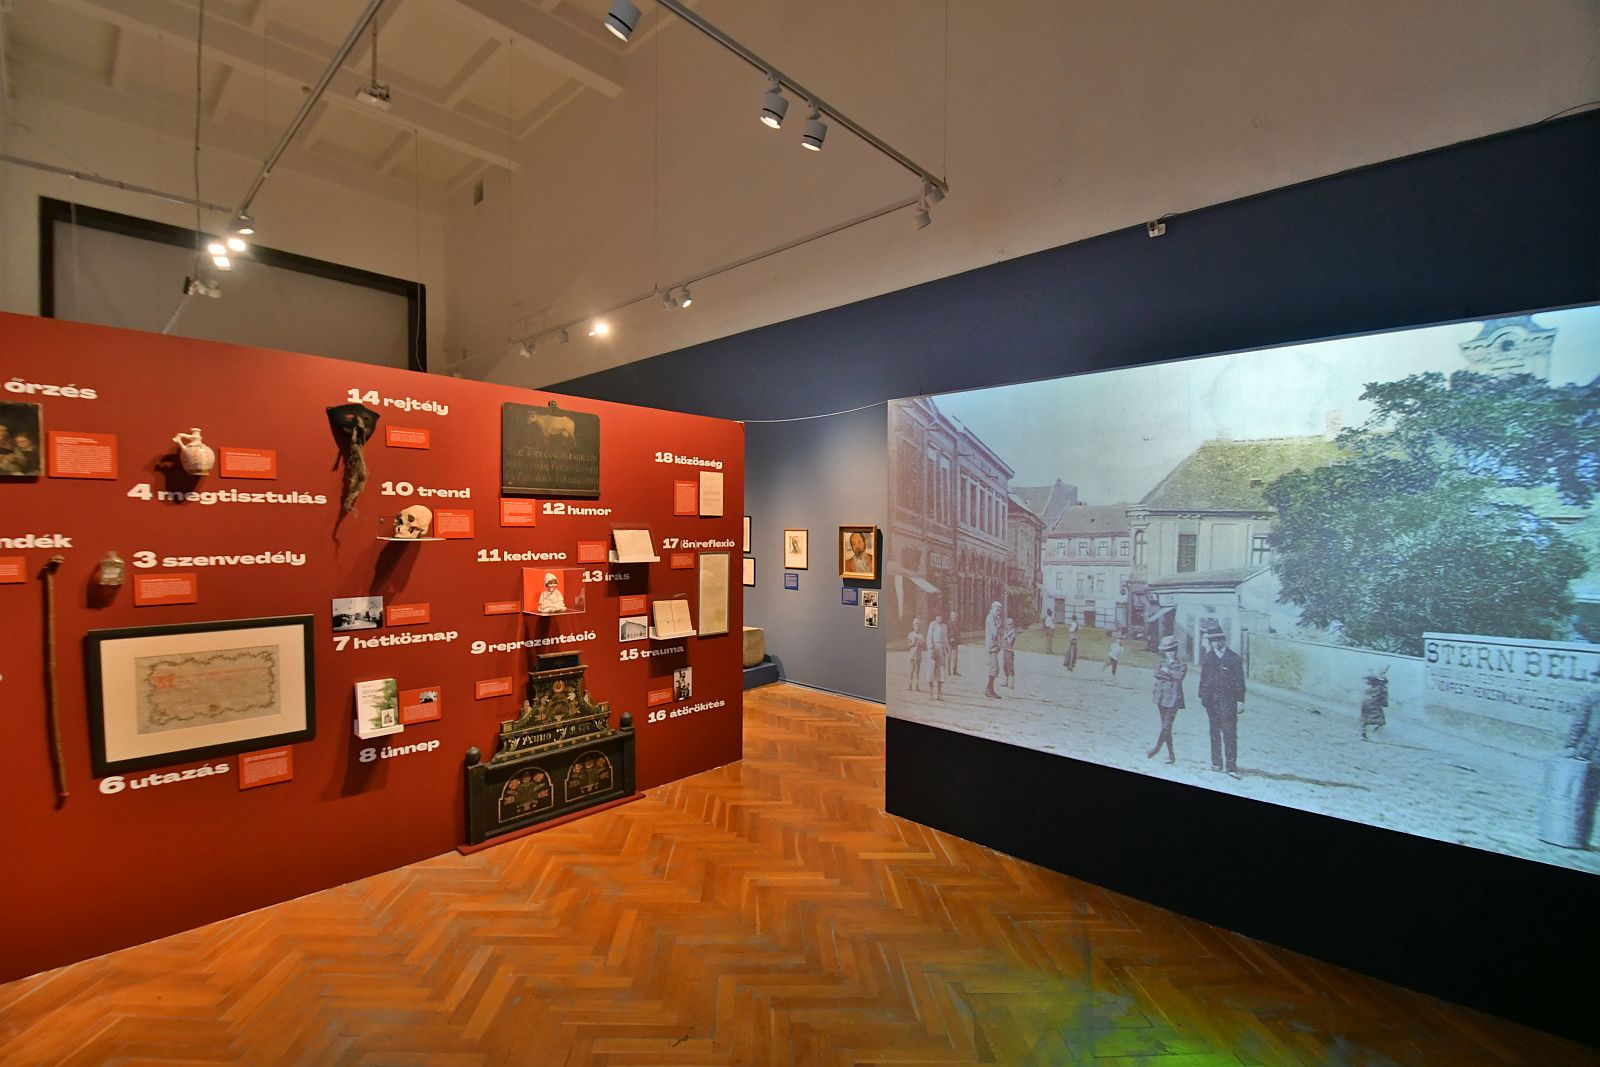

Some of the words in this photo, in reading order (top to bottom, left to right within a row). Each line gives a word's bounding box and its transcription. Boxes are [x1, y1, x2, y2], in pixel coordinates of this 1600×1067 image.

[4, 377, 98, 399] őrzés
[347, 388, 380, 406] 14
[384, 396, 449, 416] rejtély
[654, 451, 673, 464] 18
[674, 455, 723, 469] közösség
[127, 483, 152, 501] 4
[157, 489, 328, 506] megtisztulás
[381, 481, 414, 497] 10
[417, 485, 471, 499] trend
[542, 502, 565, 515] 12
[567, 504, 612, 516] humor
[662, 538, 679, 549] 17
[132, 550, 157, 569] 3
[161, 550, 308, 569] szenvedély
[477, 549, 502, 562] 11
[503, 550, 567, 562] kedvenc
[581, 570, 603, 583] 13
[333, 635, 351, 652] 7
[354, 630, 458, 649] hétköznap
[470, 639, 487, 655] 9
[488, 631, 596, 653] reprezentáció
[619, 648, 640, 662] 15
[640, 644, 684, 659] trauma
[1427, 642, 1514, 673] STERN
[647, 709, 666, 723] 16
[669, 698, 726, 718] átörökítés
[358, 746, 377, 763] 8
[380, 738, 441, 759] ünnep
[98, 775, 127, 795] 6
[129, 762, 230, 788] utazás
